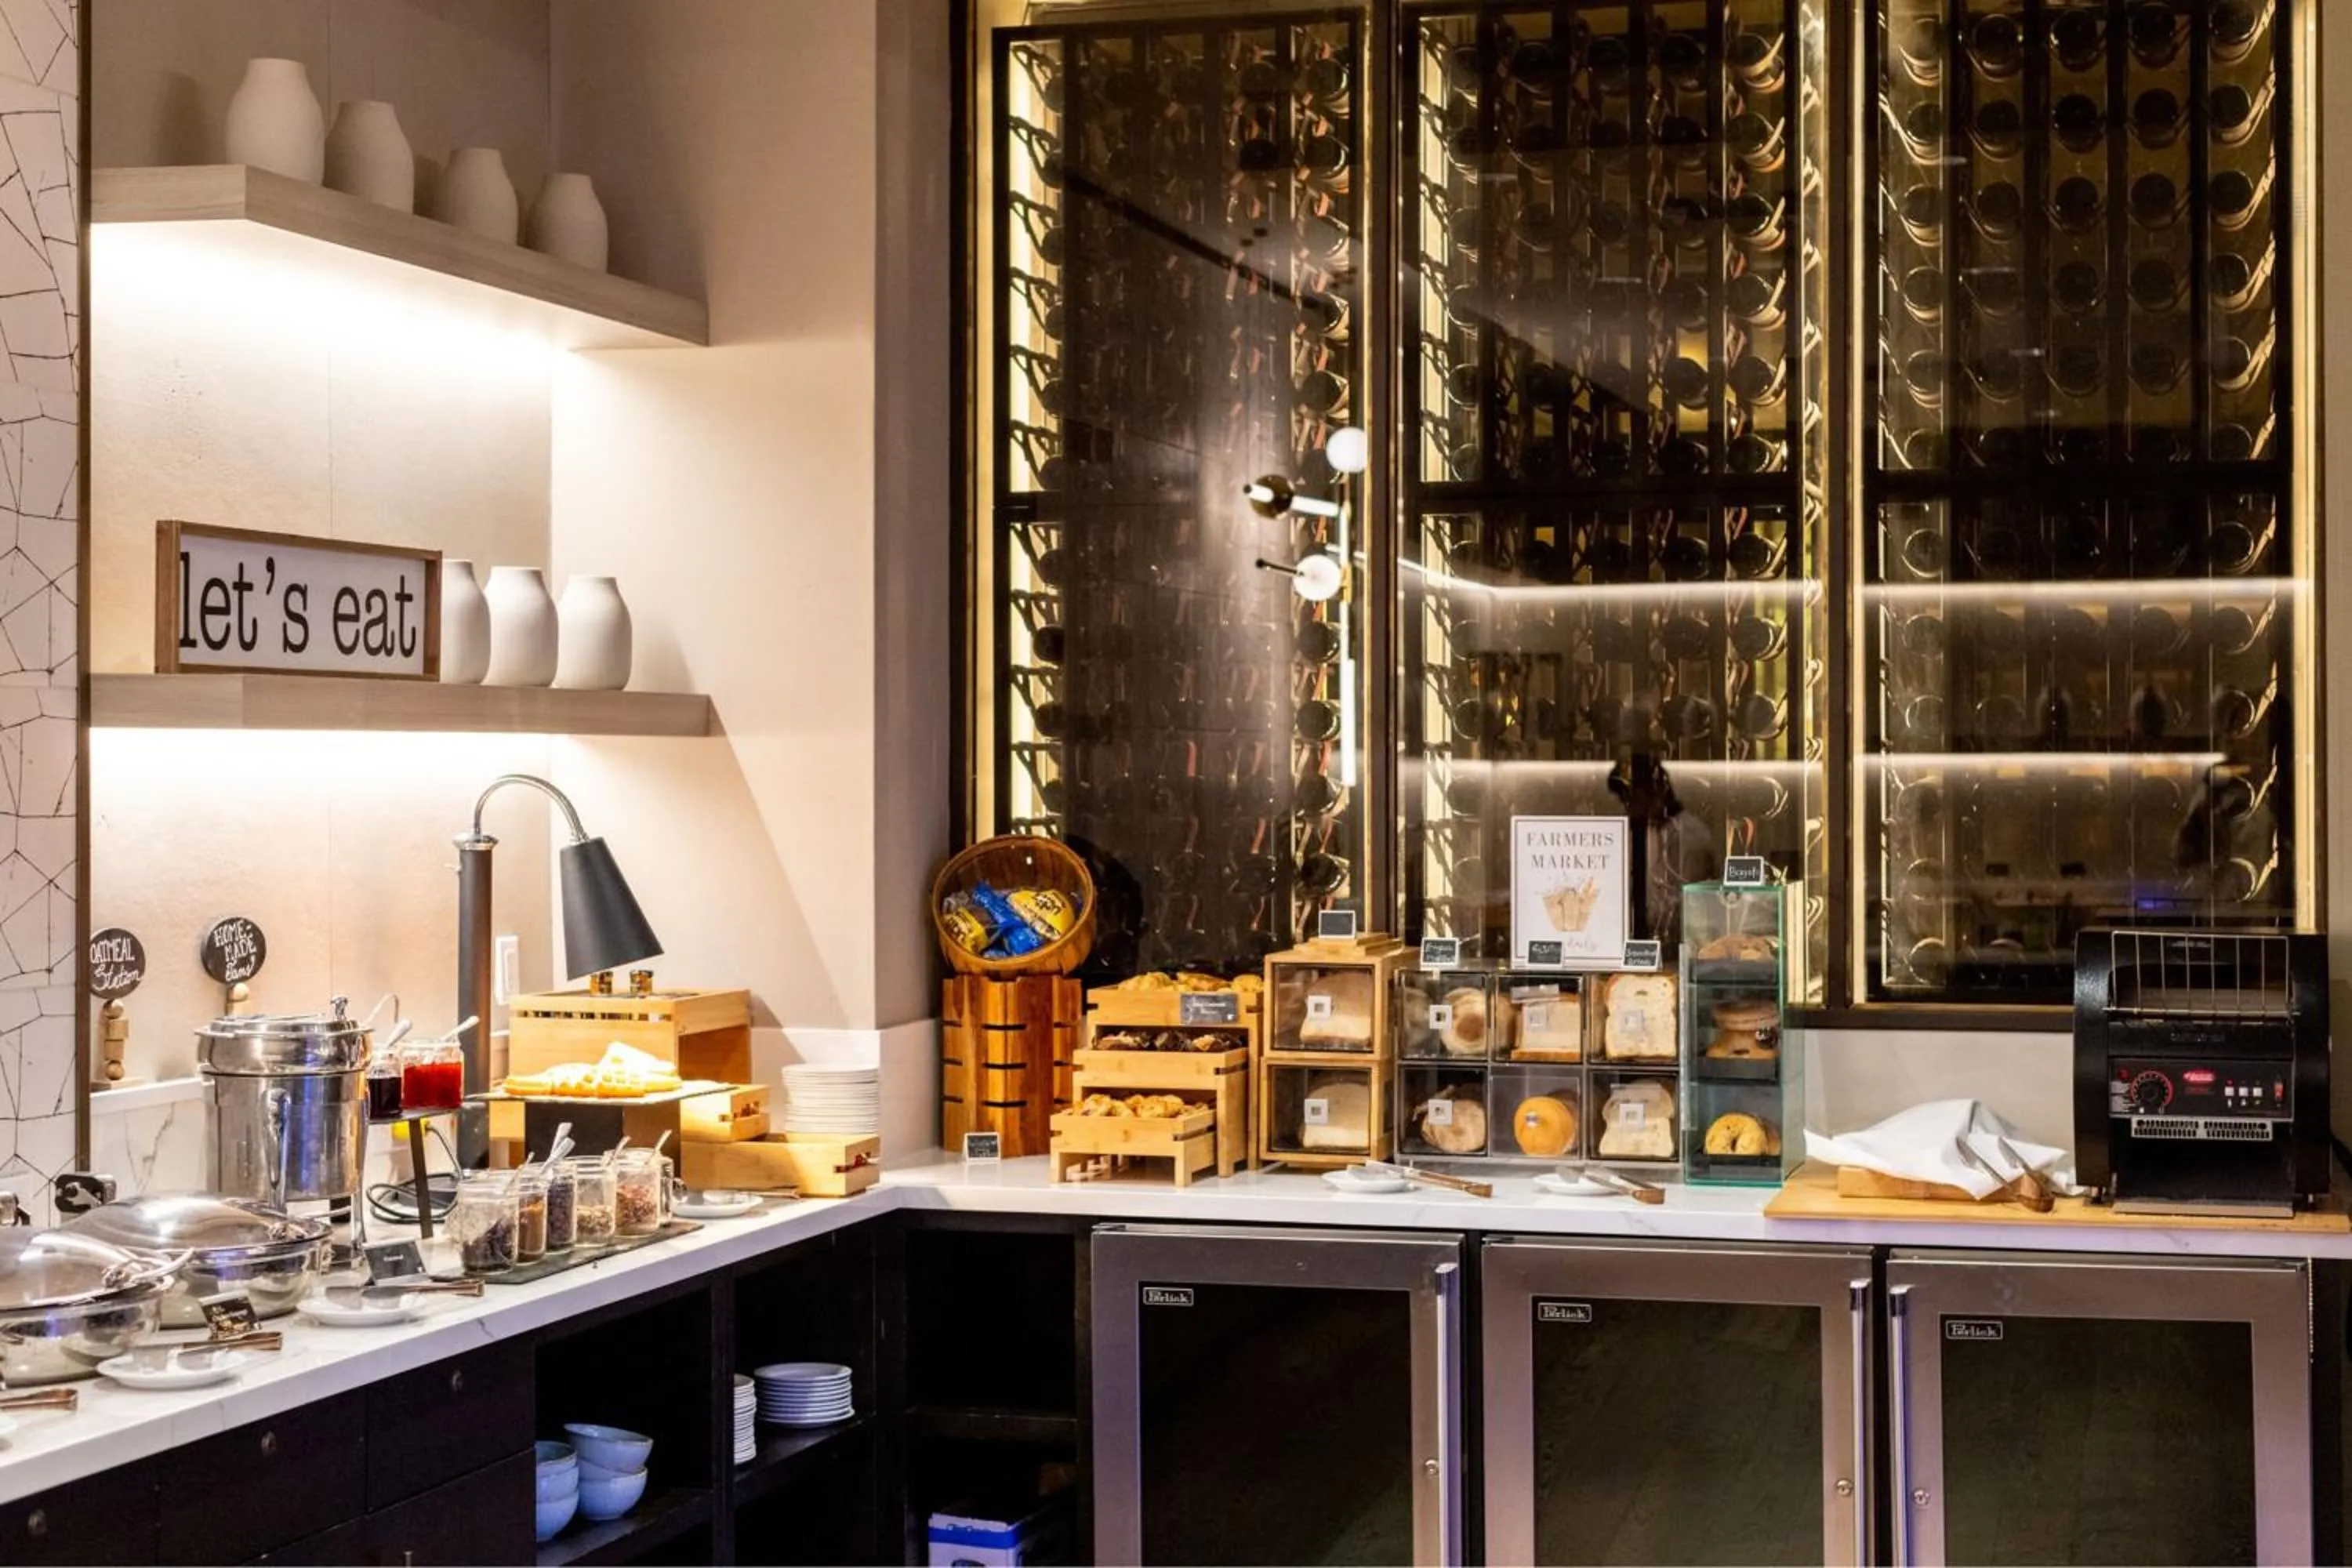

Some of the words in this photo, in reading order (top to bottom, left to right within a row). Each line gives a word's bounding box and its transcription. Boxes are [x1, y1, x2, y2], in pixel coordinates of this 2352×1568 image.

[179, 550, 310, 653] let's
[333, 574, 416, 658] eat
[1527, 832, 1615, 847] FARMERS
[1531, 855, 1610, 869] MARKET
[90, 938, 136, 964] OATMEAL
[225, 933, 257, 961] MADE
[93, 964, 144, 991] Station
